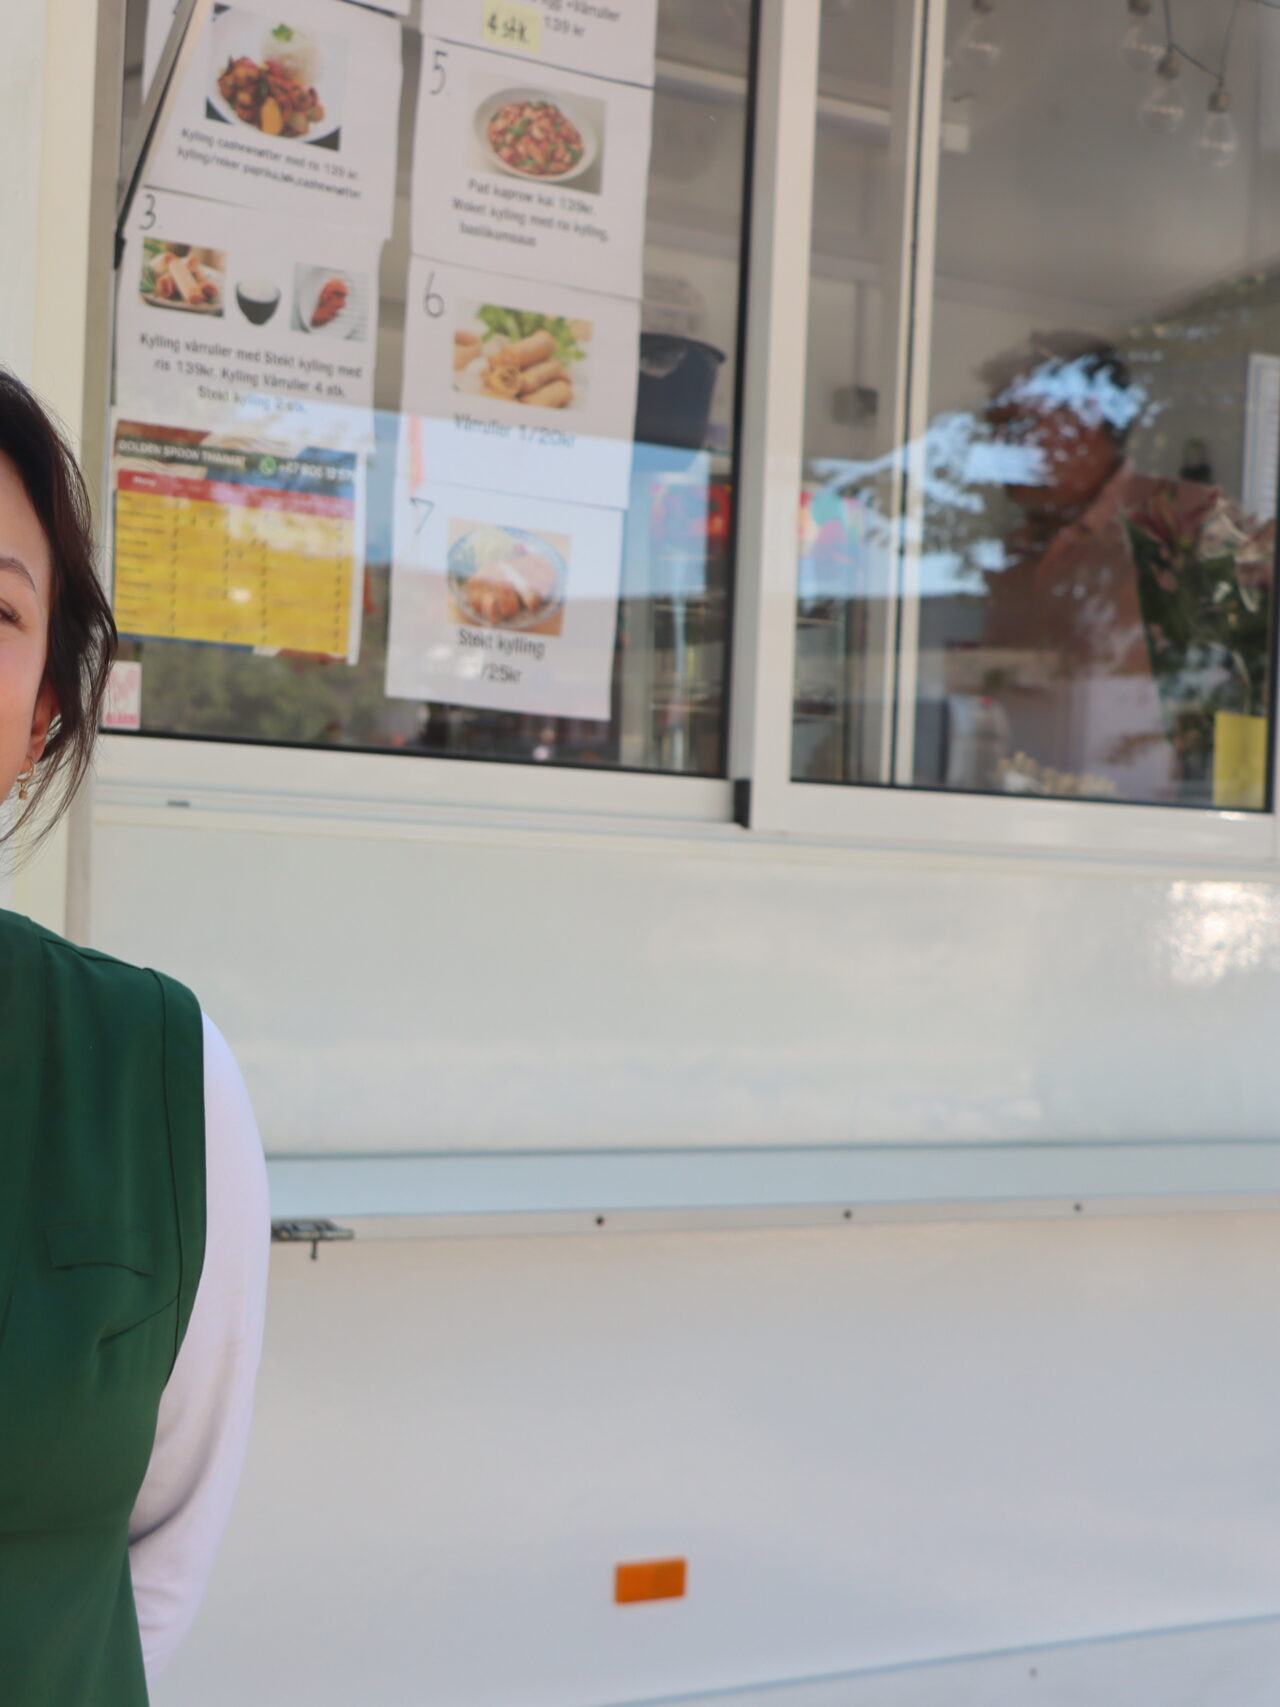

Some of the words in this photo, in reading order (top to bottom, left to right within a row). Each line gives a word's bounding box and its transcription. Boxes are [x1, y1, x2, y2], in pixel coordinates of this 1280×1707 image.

[488, 13, 499, 34] 4
[182, 128, 214, 147] Kylling
[286, 154, 307, 168] med
[490, 206, 526, 226] kylling
[530, 213, 553, 229] med
[140, 332, 181, 354] Kylling
[237, 348, 261, 363] med
[265, 353, 295, 369] Stekt
[298, 357, 334, 377] kylling
[338, 364, 363, 379] med
[154, 358, 170, 372] ris
[221, 367, 259, 387] Kylling
[315, 381, 324, 393] 4
[120, 440, 160, 455] GOLDEN
[163, 446, 199, 460] SPOON
[496, 634, 546, 661] kylling
